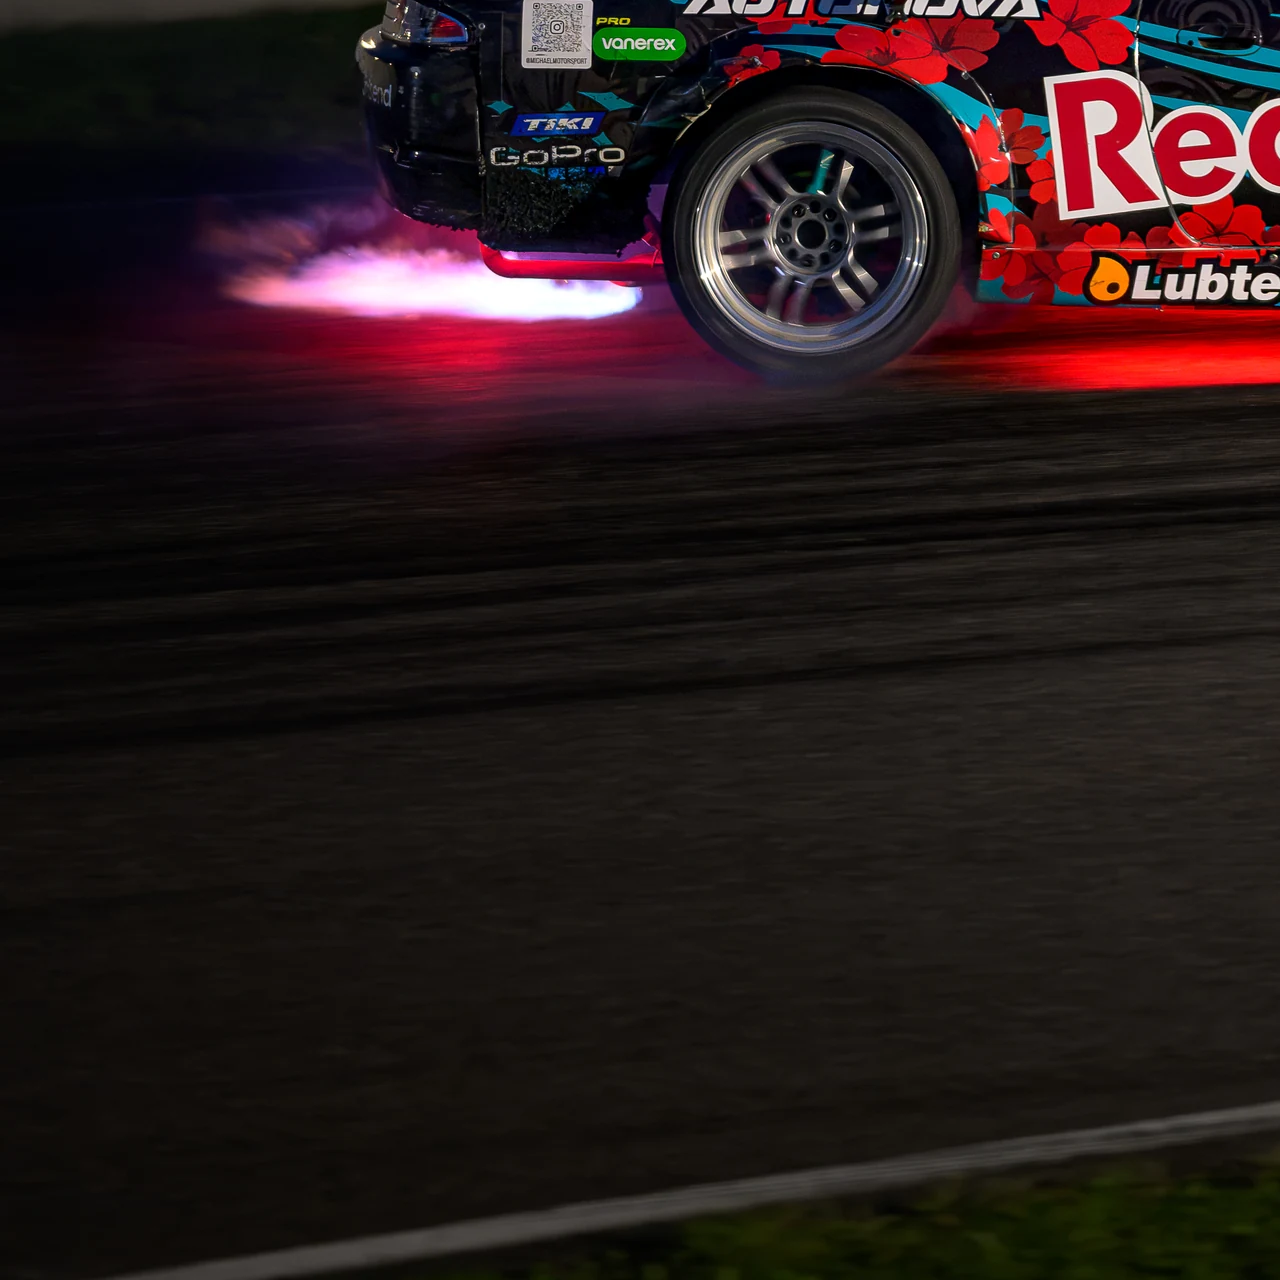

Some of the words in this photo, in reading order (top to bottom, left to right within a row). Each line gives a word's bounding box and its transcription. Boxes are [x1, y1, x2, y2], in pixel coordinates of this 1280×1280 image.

[596, 17, 631, 26] PRO
[601, 37, 677, 51] vanerex
[489, 144, 626, 167] GoPro
